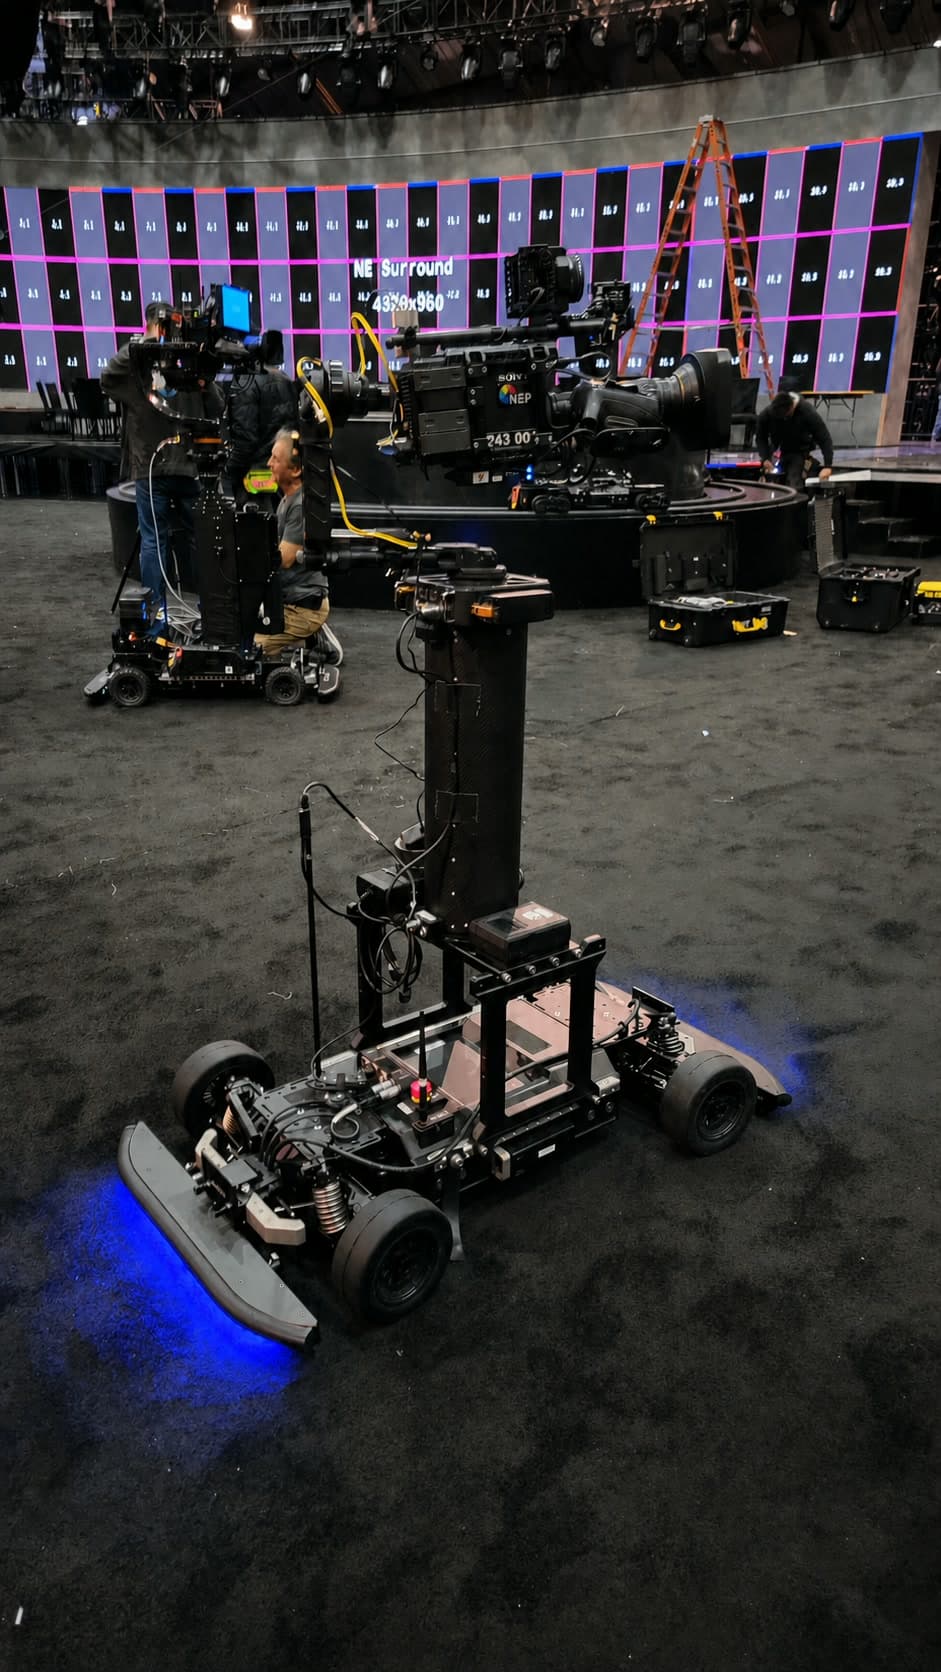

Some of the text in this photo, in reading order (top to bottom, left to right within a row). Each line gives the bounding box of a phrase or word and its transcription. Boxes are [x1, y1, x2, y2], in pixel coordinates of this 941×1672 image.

[353, 255, 454, 278] NE Surround
[509, 392, 532, 405] NEP
